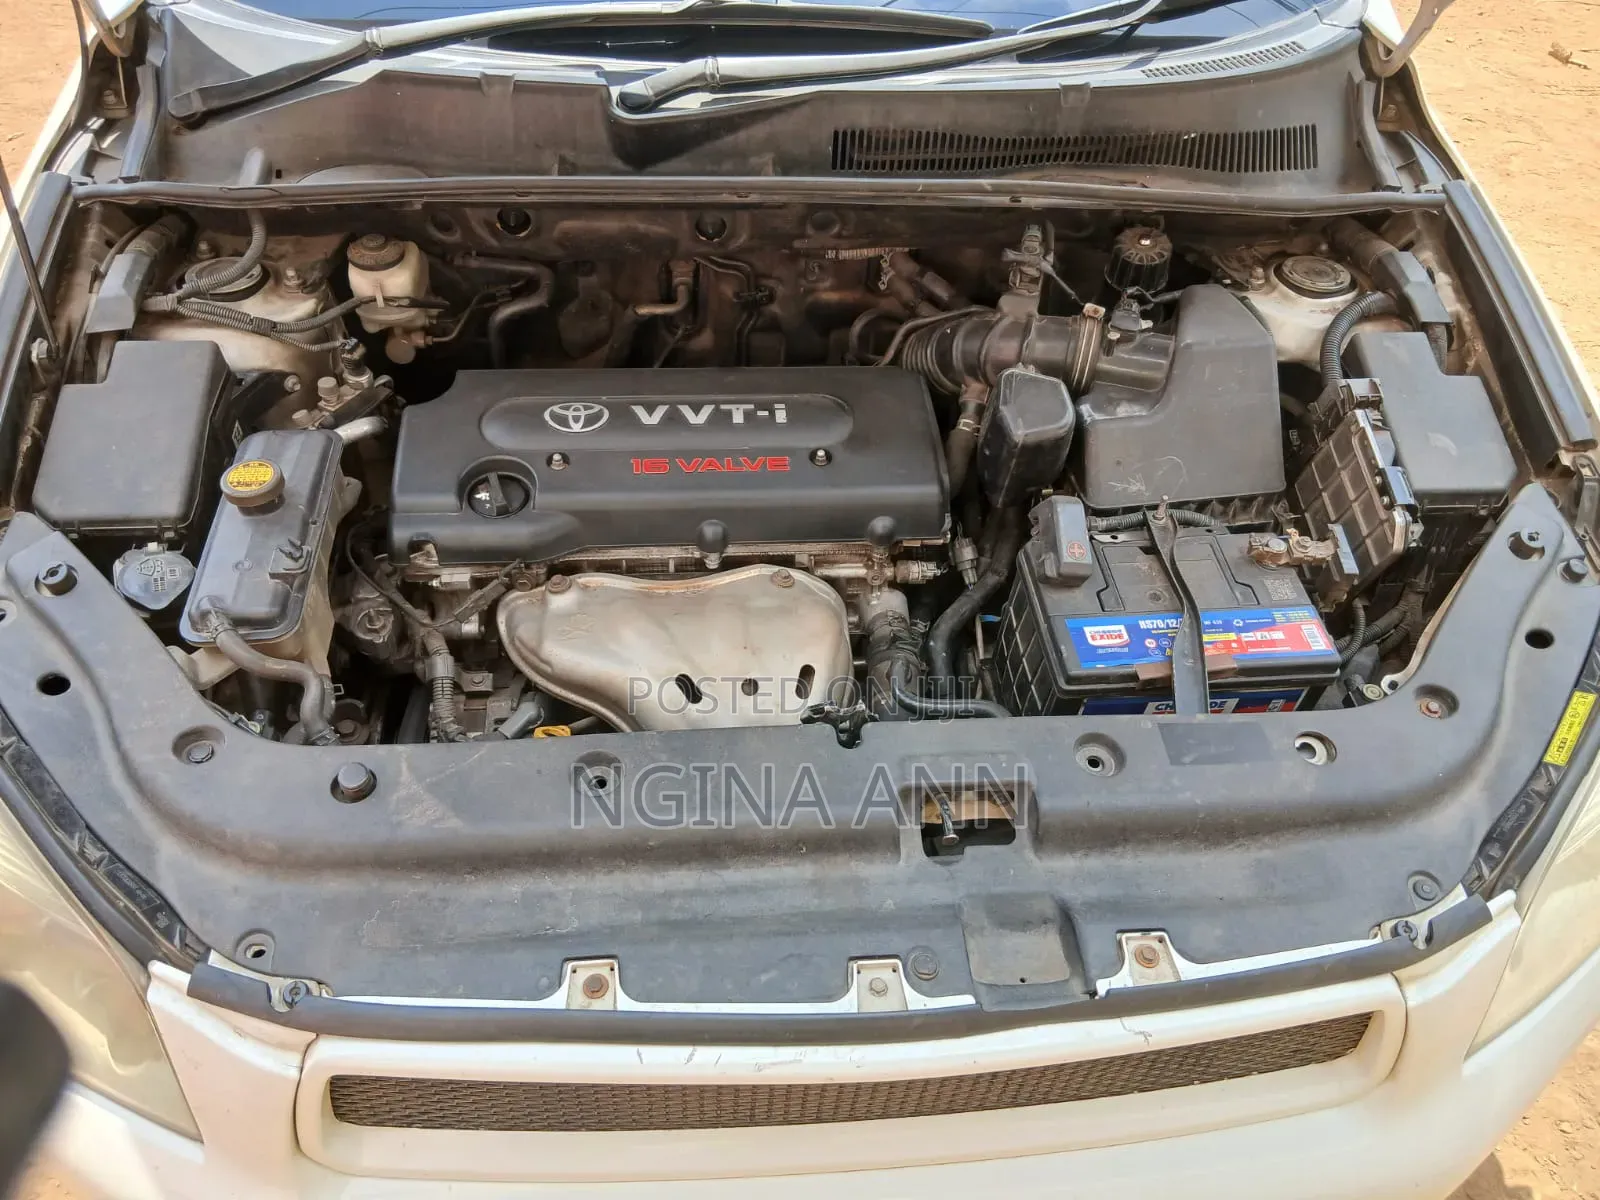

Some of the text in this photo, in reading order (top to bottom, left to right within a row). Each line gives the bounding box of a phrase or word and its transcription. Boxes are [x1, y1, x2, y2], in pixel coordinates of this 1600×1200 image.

[630, 403, 788, 425] VVT-i
[630, 456, 791, 474] 16 VALVE
